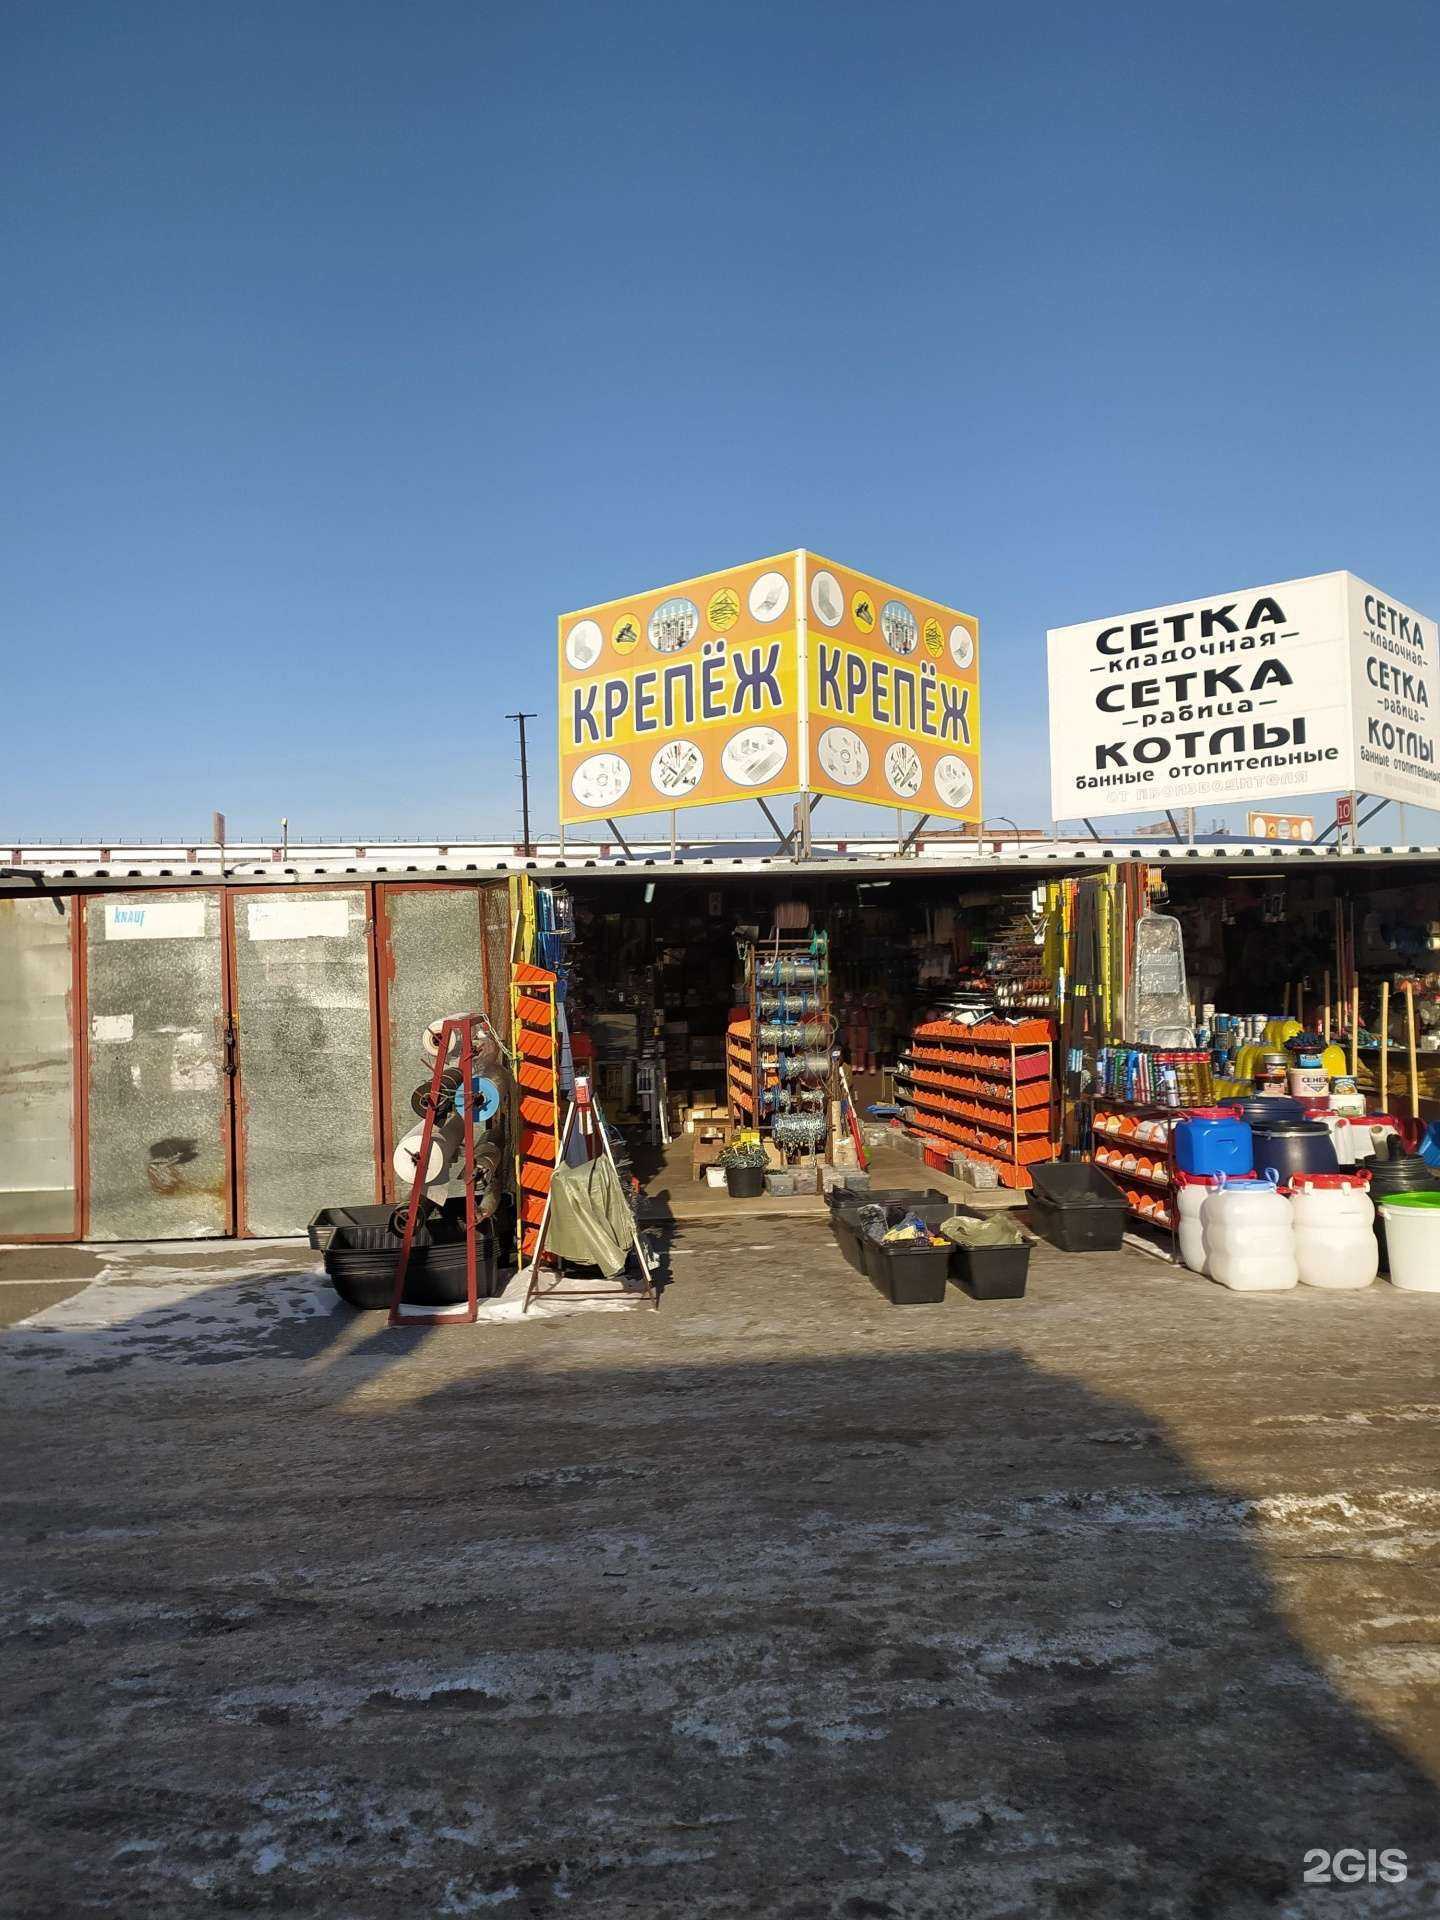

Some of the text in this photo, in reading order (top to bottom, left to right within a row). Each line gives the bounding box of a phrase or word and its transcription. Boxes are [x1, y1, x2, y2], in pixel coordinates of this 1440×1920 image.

[1095, 597, 1288, 656] СЕТКА
[1364, 594, 1424, 650] СЕТКА
[1108, 632, 1277, 674] кладочная
[1370, 631, 1423, 667] кладочная
[573, 640, 783, 744] КРЕПЁЖ
[818, 643, 970, 745] КРЕПЁЖ
[1095, 658, 1294, 713] СЕТКА
[1366, 656, 1428, 708] СЕТКА
[1142, 699, 1254, 728] рабица
[1095, 717, 1306, 771] КОТЛЫ
[1360, 746, 1390, 768] банные
[1368, 717, 1434, 763] КОТЛЫ
[1075, 747, 1339, 790] банные отопительные
[1339, 804, 1350, 819] 10
